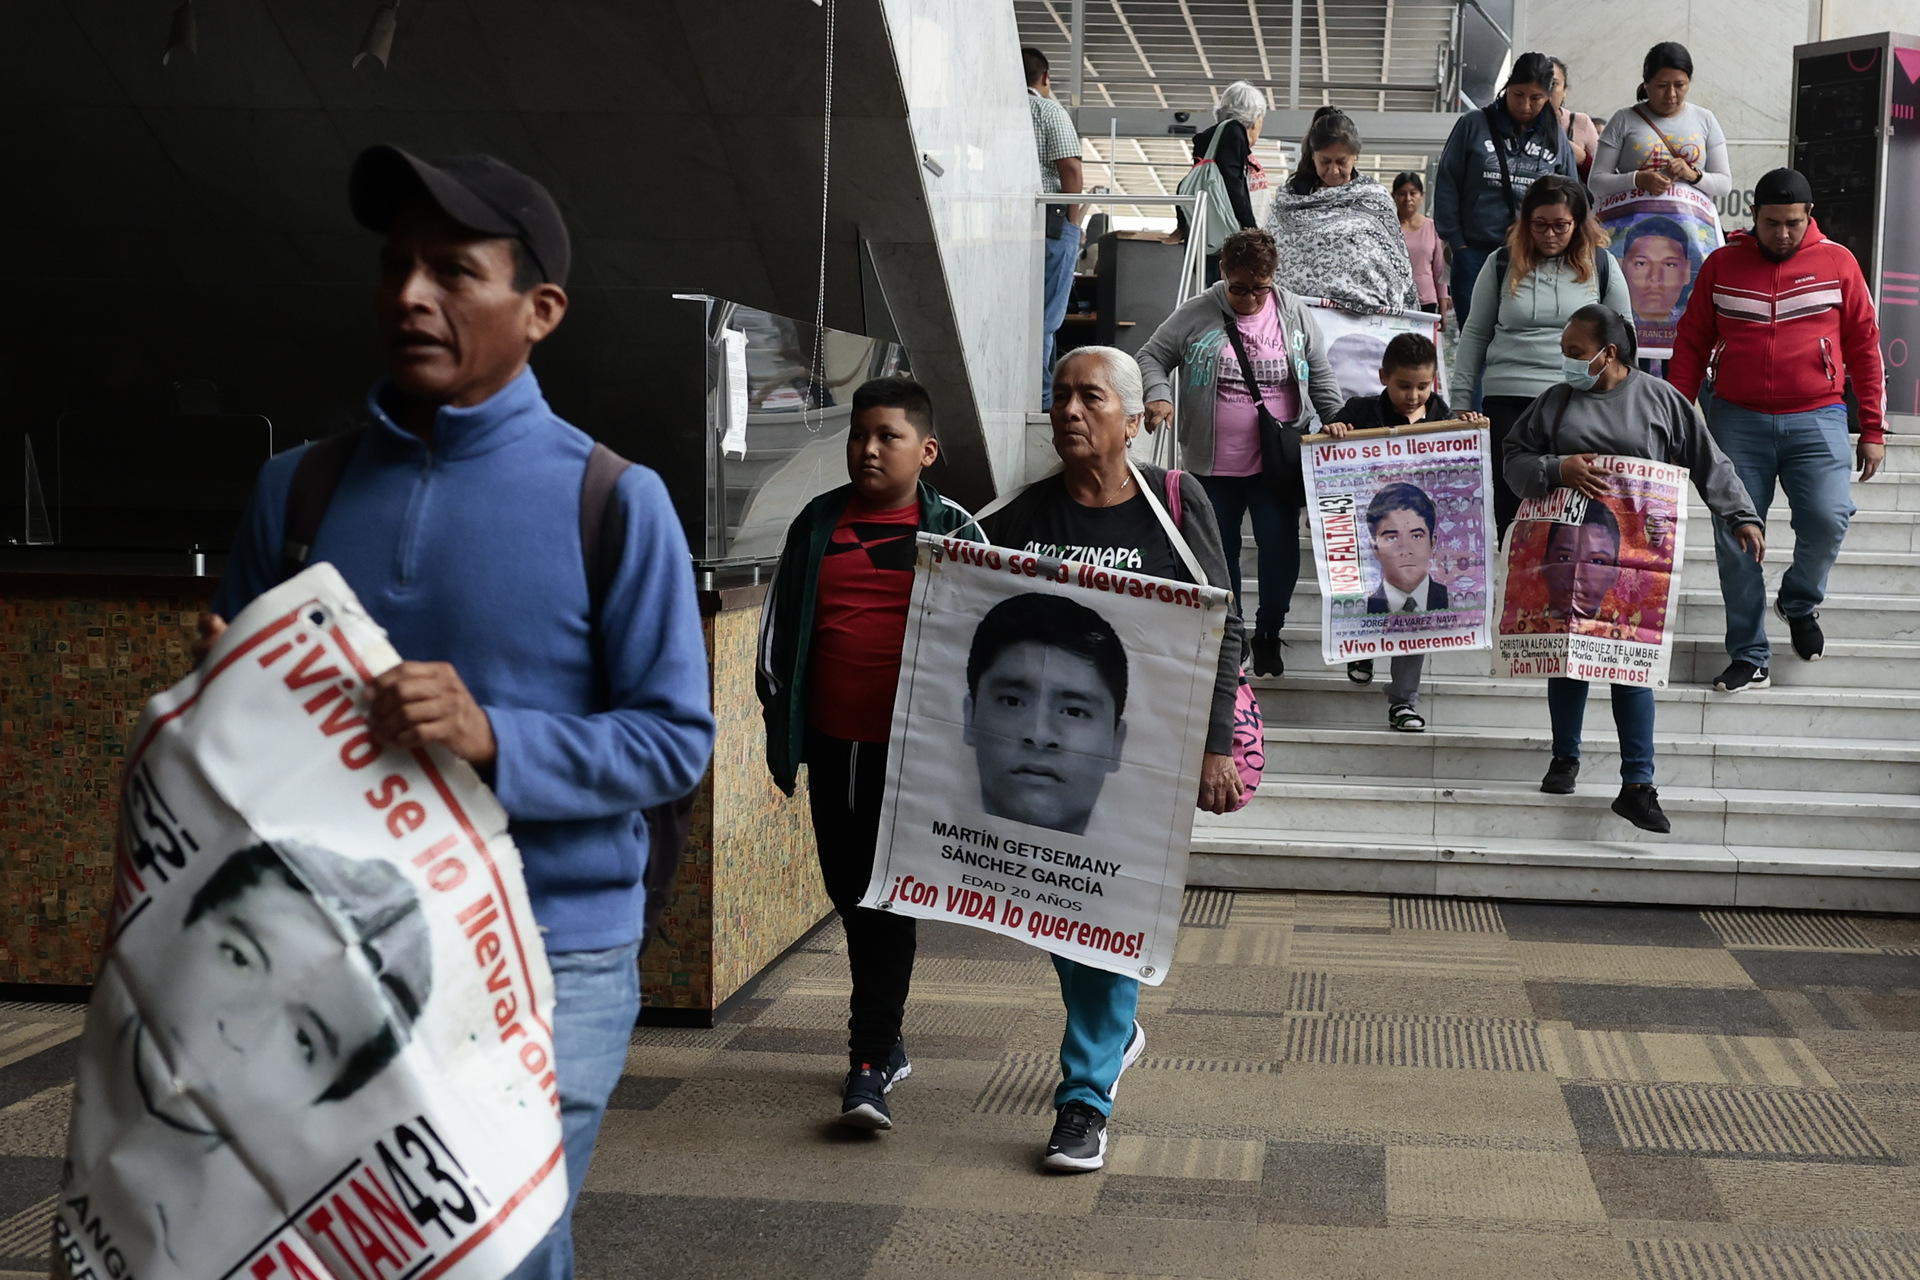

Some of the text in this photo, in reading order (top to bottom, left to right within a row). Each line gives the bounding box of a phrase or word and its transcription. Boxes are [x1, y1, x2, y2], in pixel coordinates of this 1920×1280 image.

[1630, 188, 1646, 198] se
[1315, 445, 1357, 466] ¡Vivo
[1362, 445, 1381, 458] se
[1387, 441, 1402, 456] lo
[1406, 434, 1478, 455] llevaron!
[1602, 457, 1682, 484] llevaron!
[1009, 553, 1037, 578] se
[1046, 563, 1070, 584] o
[1077, 563, 1200, 609] llevaron!
[1329, 565, 1361, 592] NOS
[1360, 619, 1389, 629] JORGE
[1436, 614, 1458, 624] NAVA
[1339, 631, 1476, 658] ¡Vivo lo queremos!
[1500, 637, 1659, 660] CHRISTIAN ALFONSO RODRÍGUEZ TELUMBRE
[1513, 650, 1519, 658] de
[1521, 649, 1549, 658] Clemente
[1622, 656, 1631, 665] 19
[1510, 658, 1650, 683] ¡Con VIDA lo queremos!
[257, 633, 385, 772] ¡Vivo
[364, 773, 427, 840] se
[411, 833, 469, 894] lo
[932, 820, 1121, 878] MARTÍN GETSEMANY
[941, 845, 1104, 897] SÁNCHEZ GARCÍA
[961, 873, 1083, 912] EDAD 20 AÑOS
[888, 875, 1145, 960] ¡Con VIDA lo queremos!
